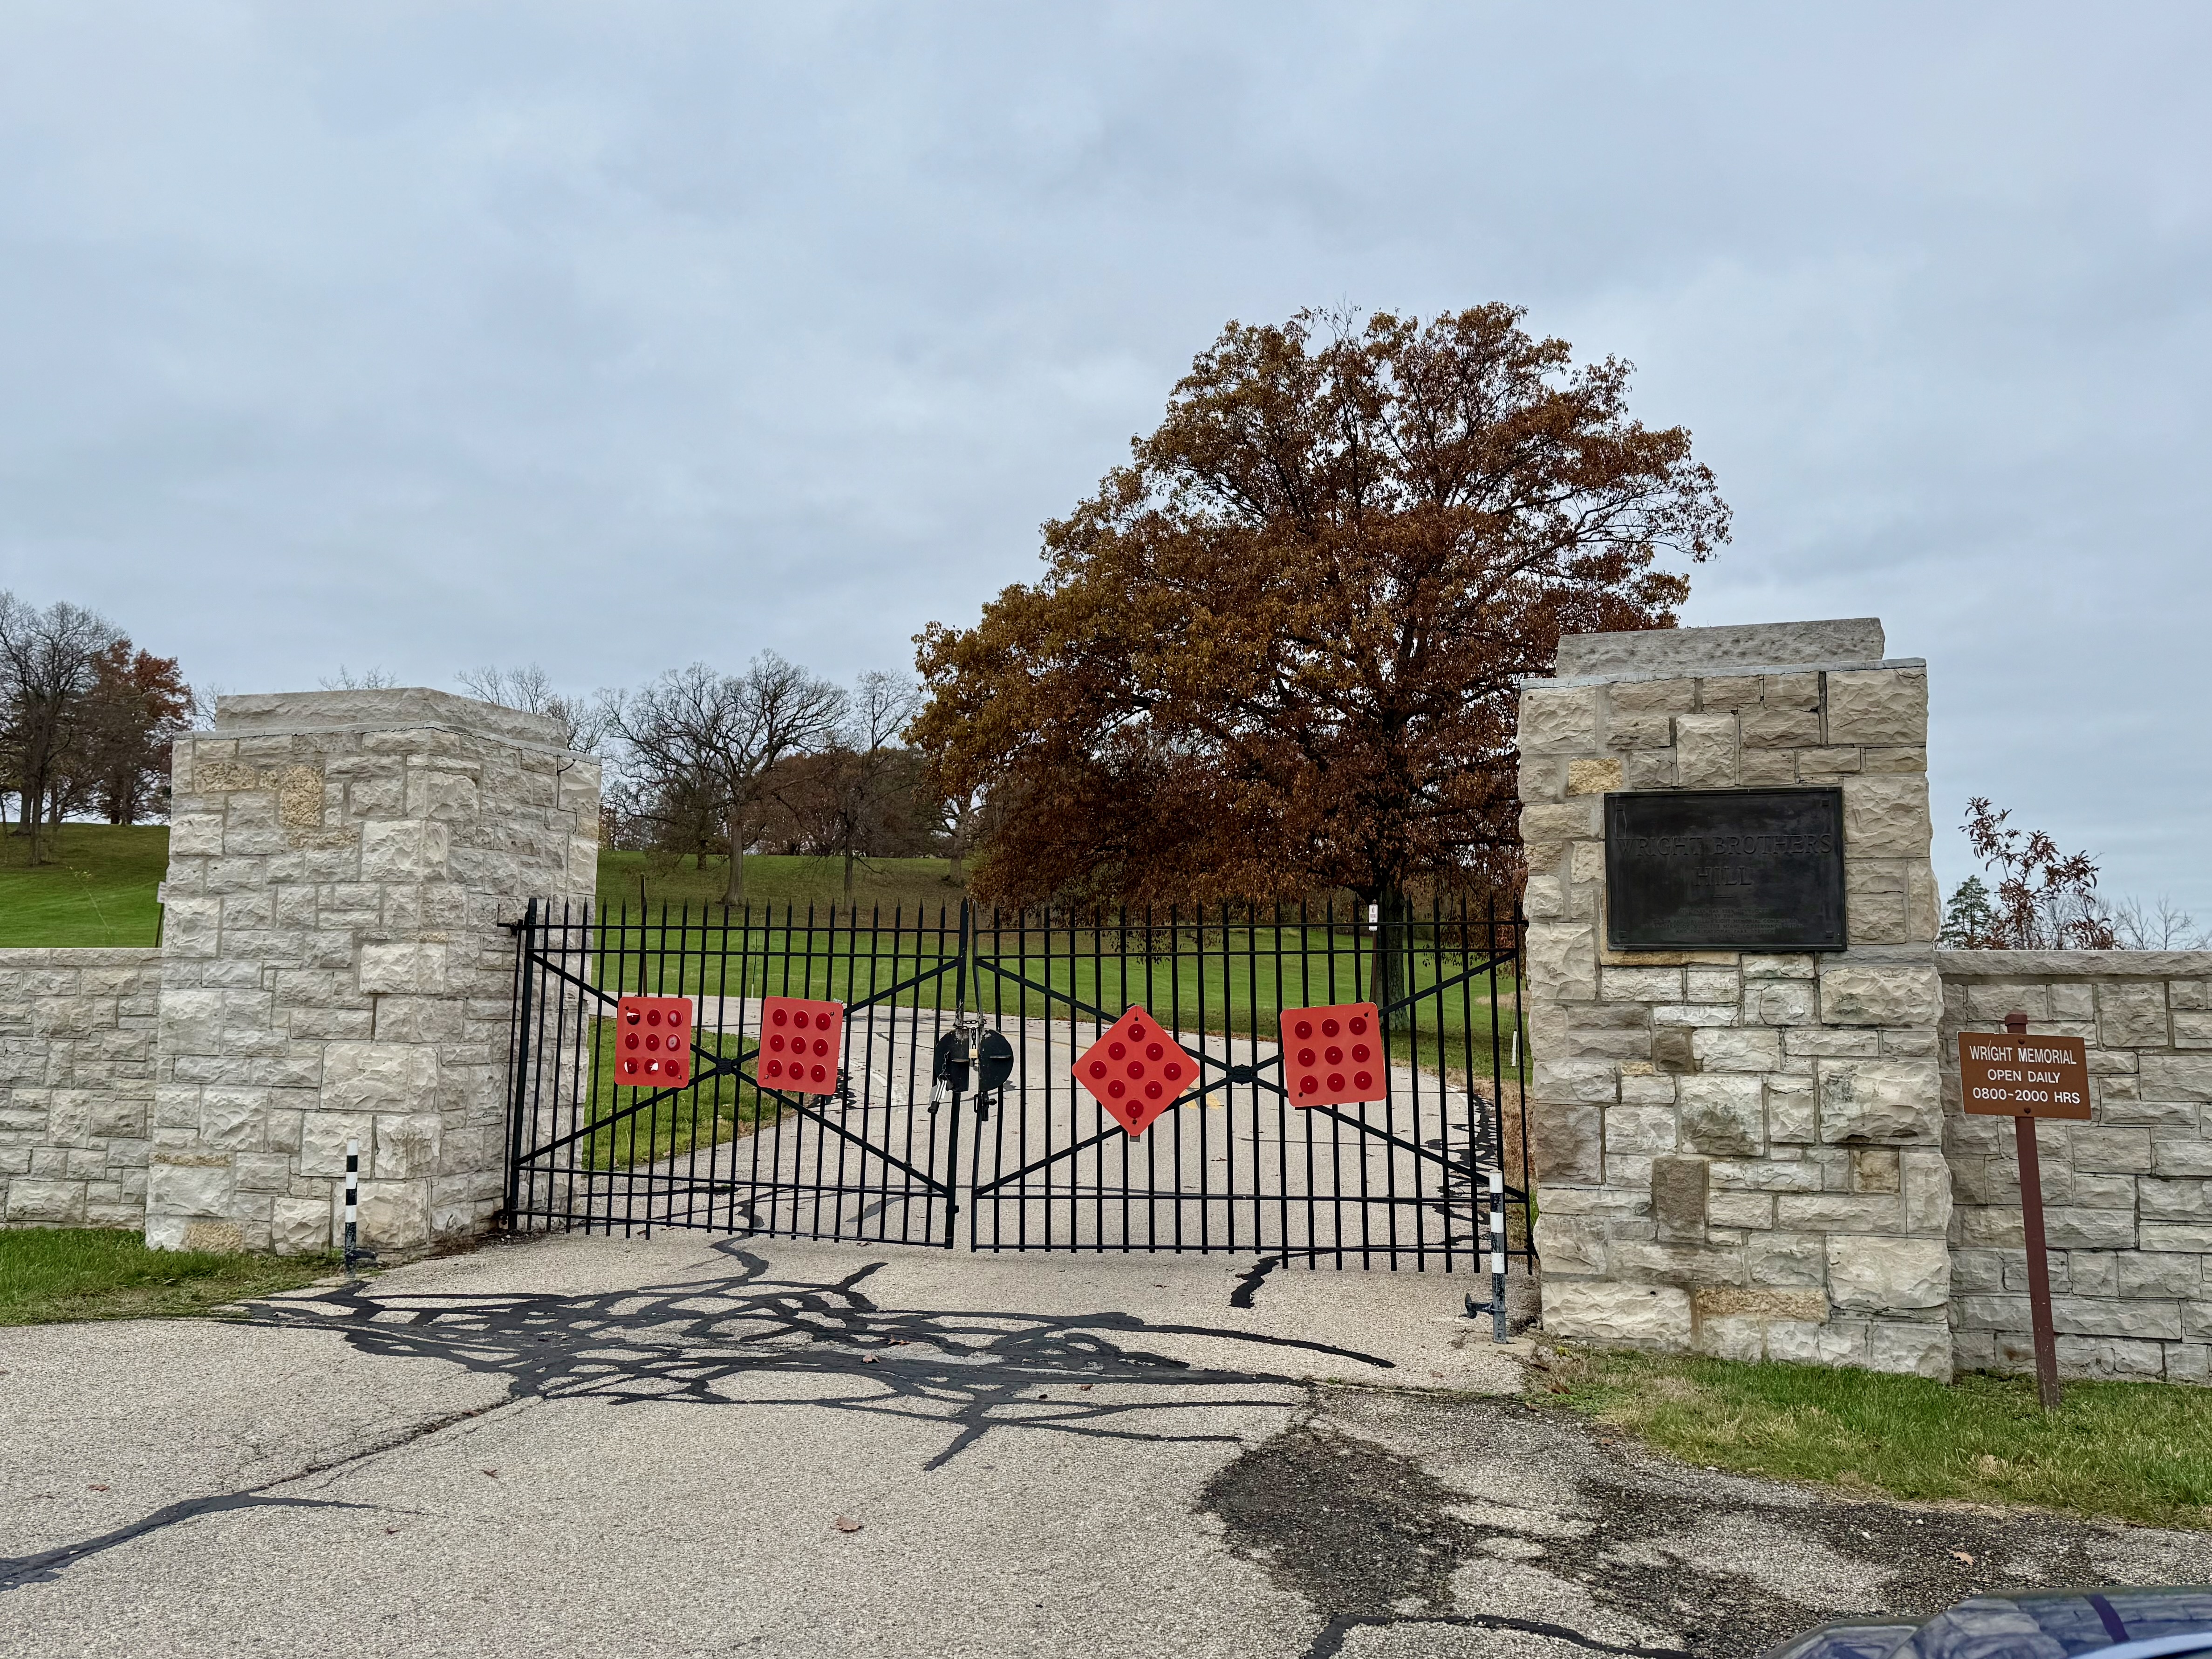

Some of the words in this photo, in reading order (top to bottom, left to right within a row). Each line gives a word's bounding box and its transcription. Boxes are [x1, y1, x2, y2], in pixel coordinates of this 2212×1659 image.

[1616, 837, 1703, 856] WRIGHT
[1712, 833, 1833, 855] BROTHERS
[1693, 866, 1754, 886] HILL
[1969, 1045, 2013, 1062] WRIGHT
[2018, 1048, 2077, 1065] MEMORIAL
[1987, 1069, 2021, 1081] OPEN
[2028, 1071, 2061, 1083] DAILY
[1973, 1087, 2048, 1102] 0800-2000
[2054, 1092, 2080, 1104] HRS
